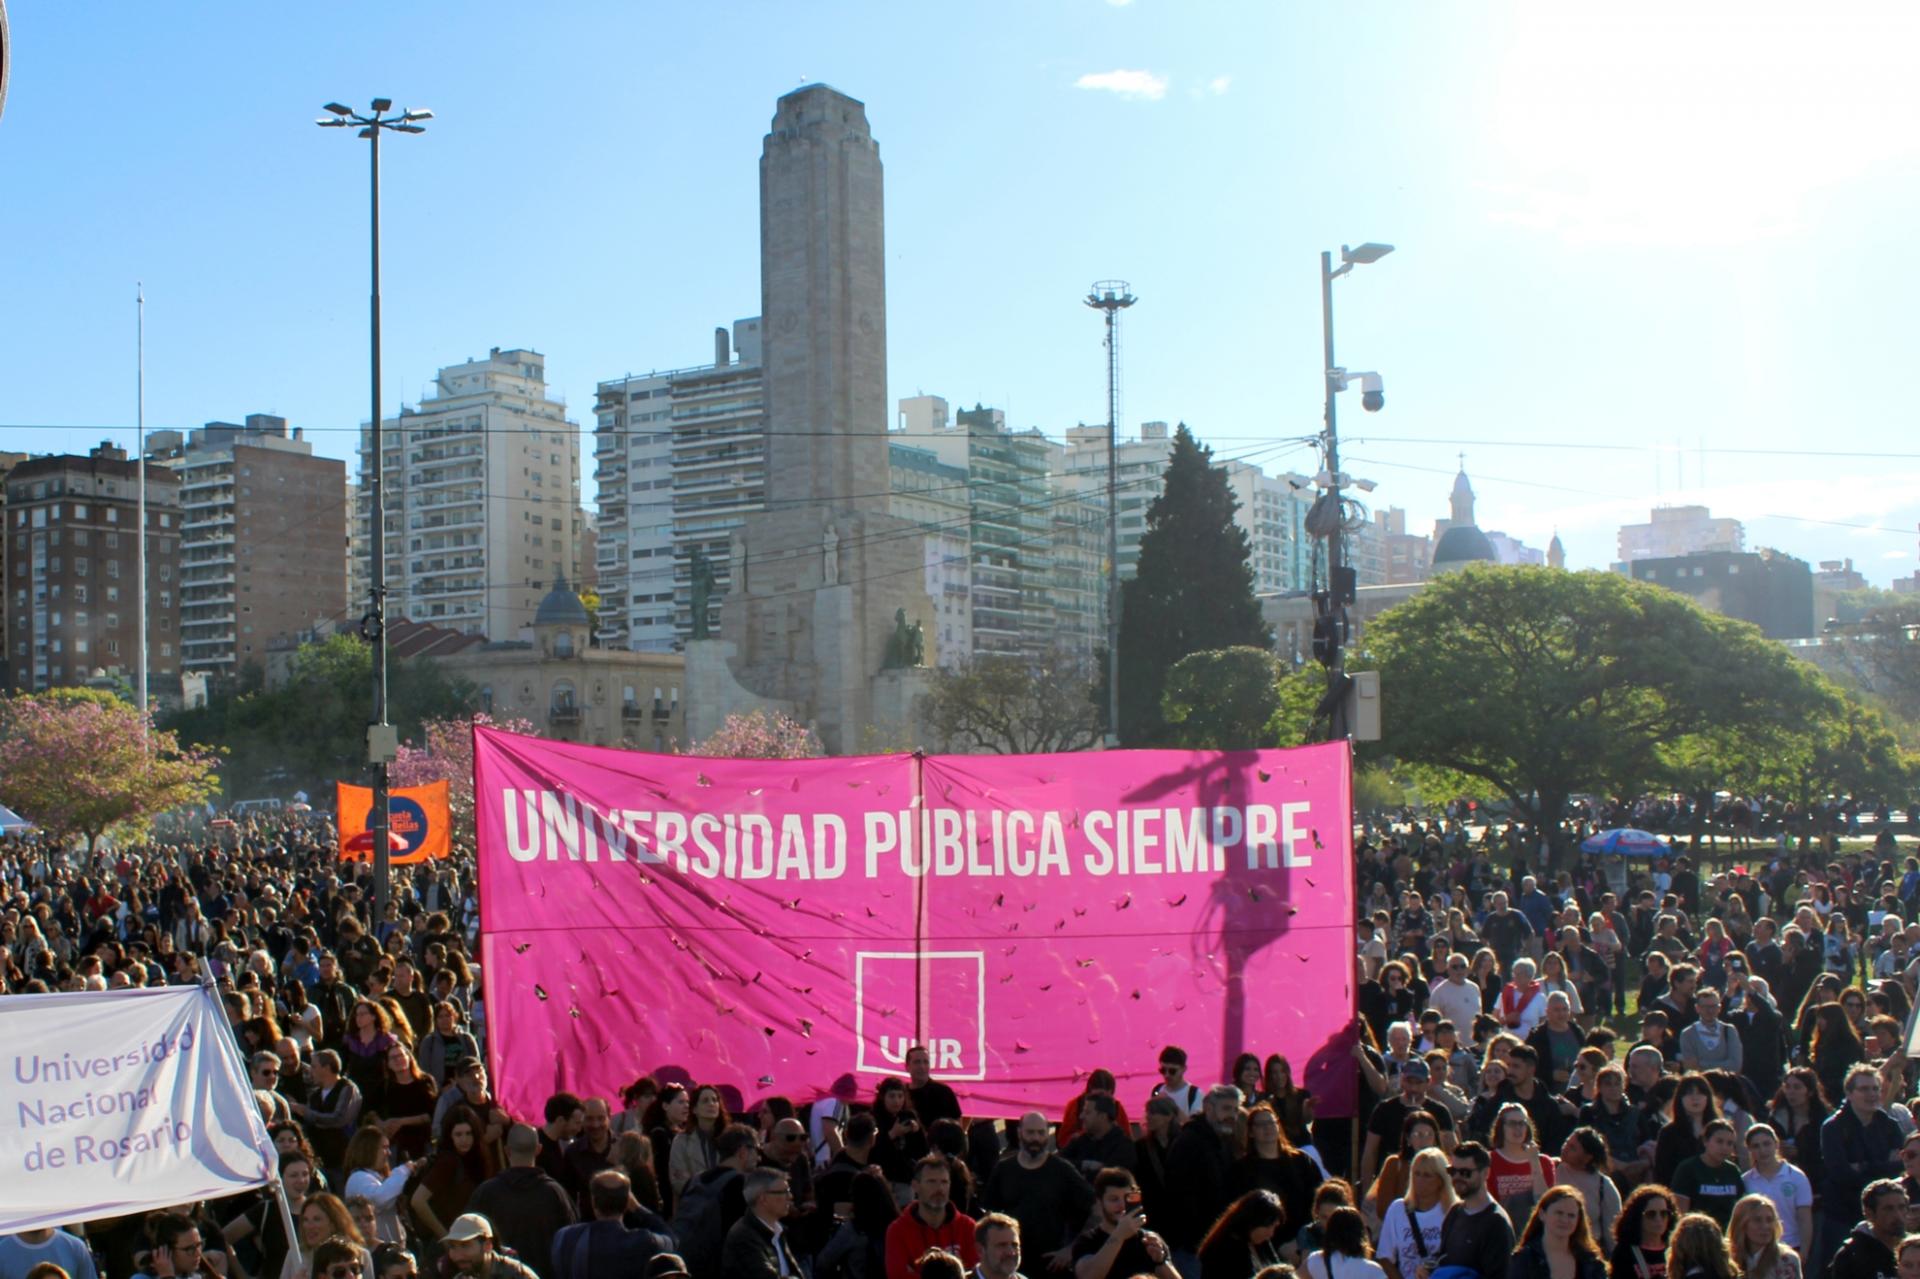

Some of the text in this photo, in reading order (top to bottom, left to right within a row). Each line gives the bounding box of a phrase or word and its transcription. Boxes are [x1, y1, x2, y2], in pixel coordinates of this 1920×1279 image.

[503, 788, 1312, 880] UNIVERSIDAD PÚBLICA SIEMPRE
[24, 1117, 192, 1172] de Rosario
